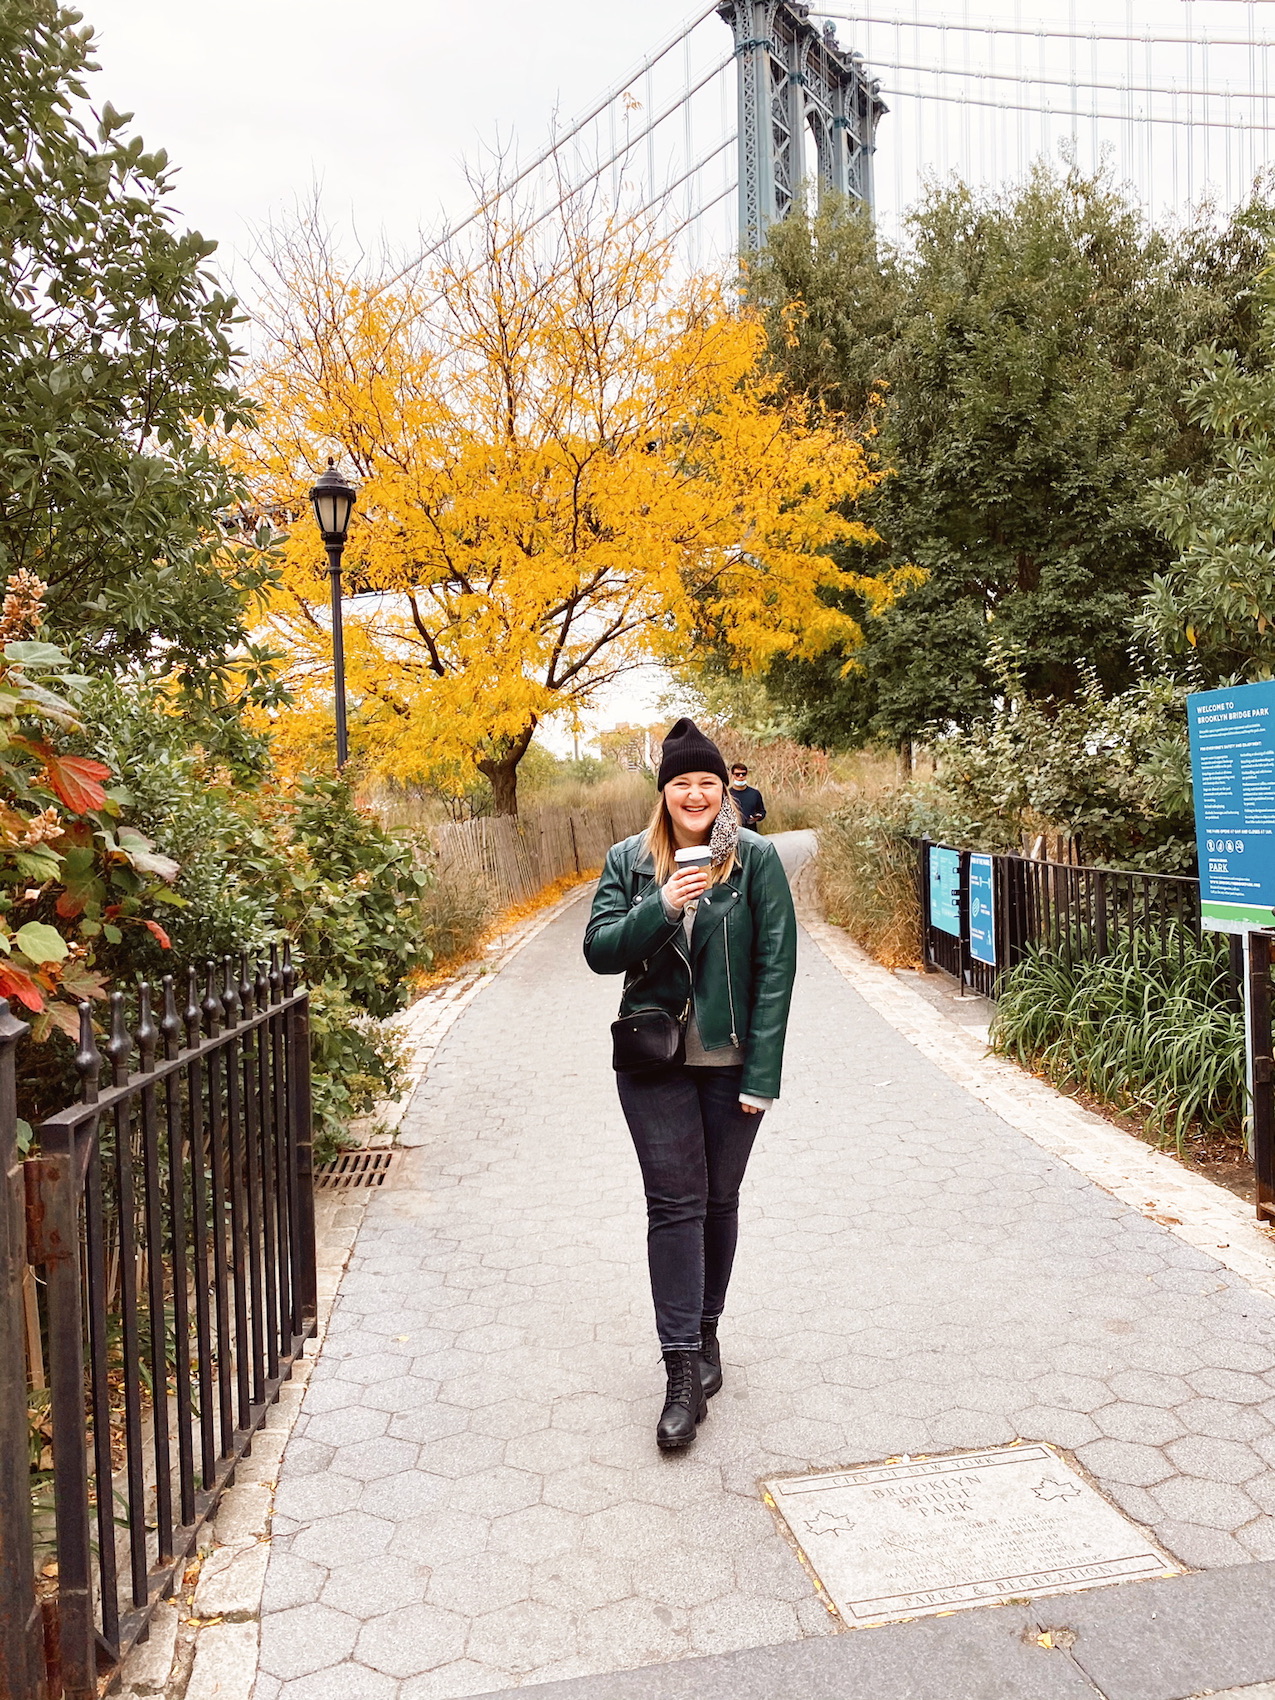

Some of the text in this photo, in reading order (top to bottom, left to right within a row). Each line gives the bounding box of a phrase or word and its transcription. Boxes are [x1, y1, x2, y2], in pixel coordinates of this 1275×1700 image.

[1197, 703, 1225, 714] WELCOME
[1197, 708, 1269, 724] BROOKLYN BRIDGE PARK
[1208, 863, 1228, 871] PARK
[831, 1474, 869, 1485] CITY
[907, 1464, 943, 1474] NEW
[950, 1456, 995, 1468] YORK
[871, 1474, 983, 1498] BROOKLYN
[896, 1487, 977, 1507] BRIDGE
[918, 1500, 974, 1517] PARK
[901, 1588, 965, 1606] PARKS
[969, 1584, 988, 1595] &
[993, 1564, 1115, 1592] RECREATION
